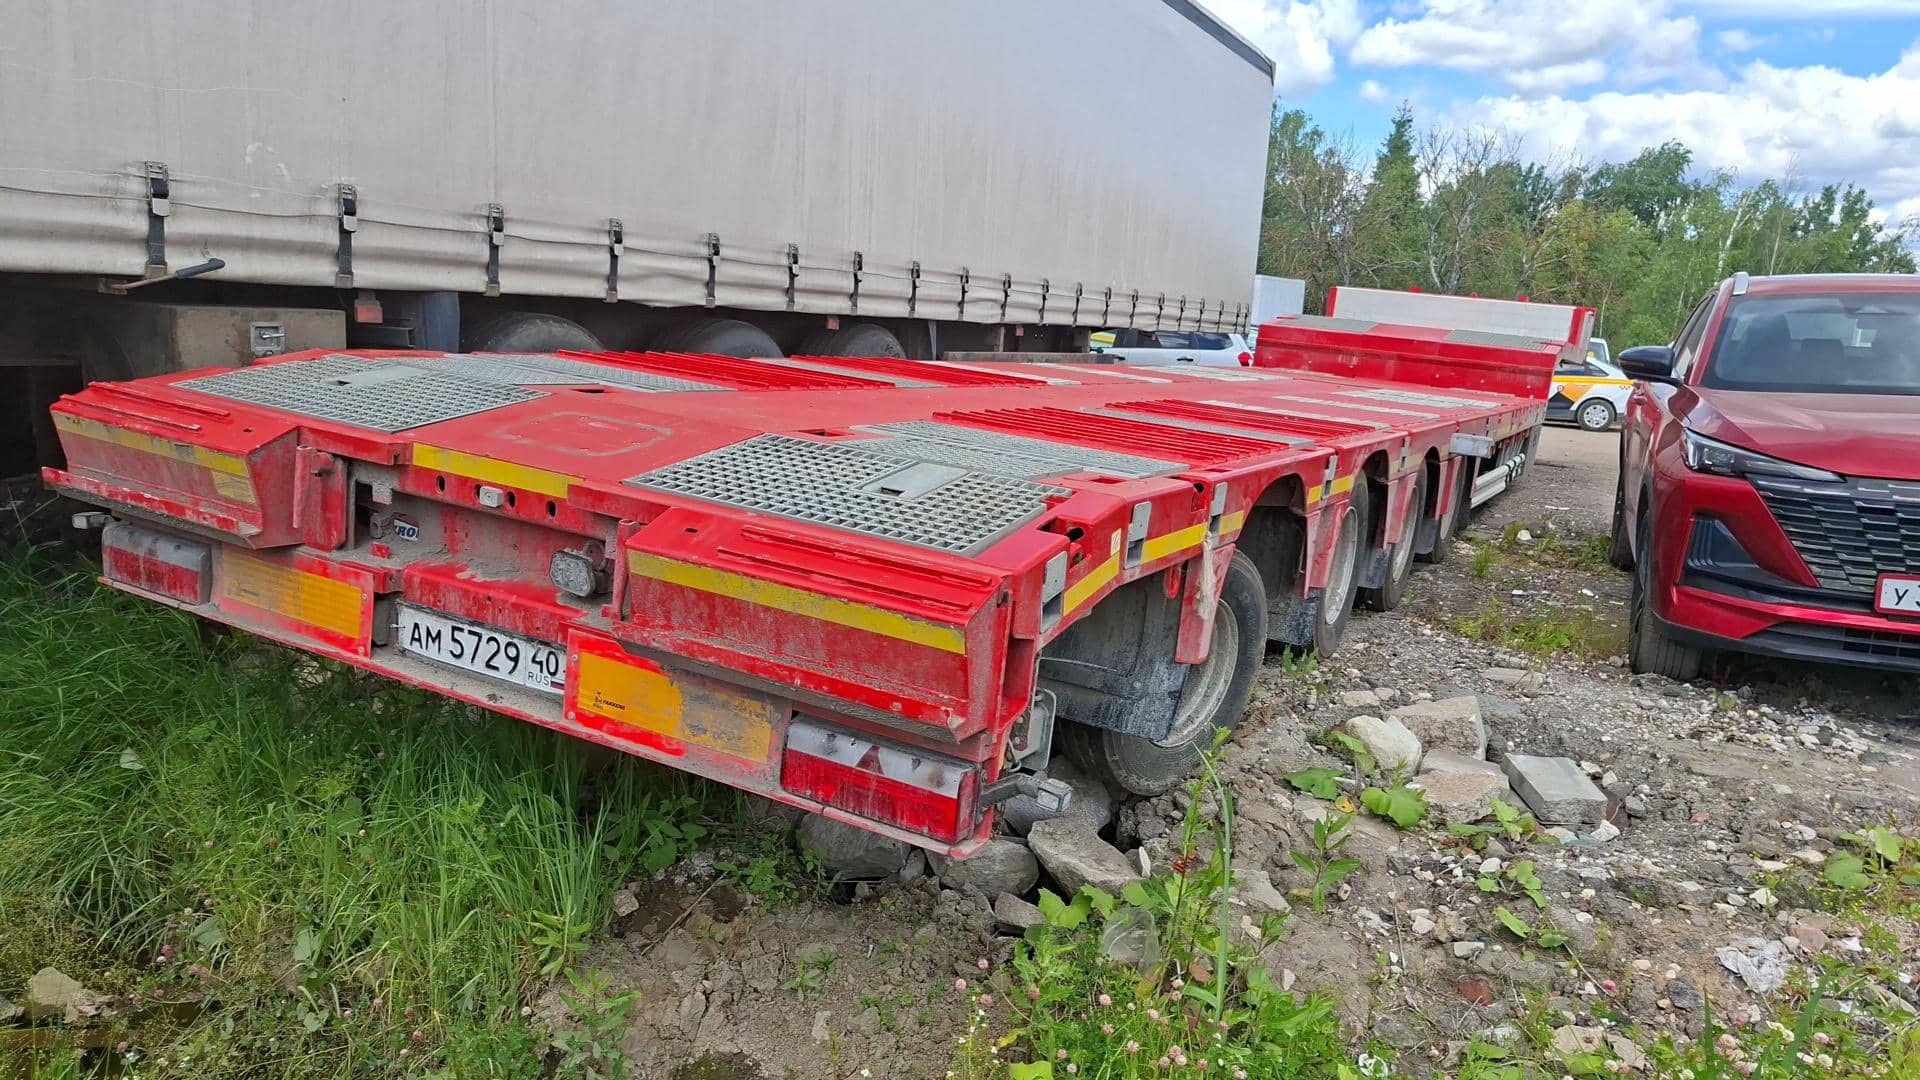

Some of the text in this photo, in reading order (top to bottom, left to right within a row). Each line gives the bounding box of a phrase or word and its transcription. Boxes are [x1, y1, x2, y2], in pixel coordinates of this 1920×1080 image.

[449, 625, 521, 675] 5729
[531, 648, 559, 677] 40
[527, 671, 550, 686] RUS
